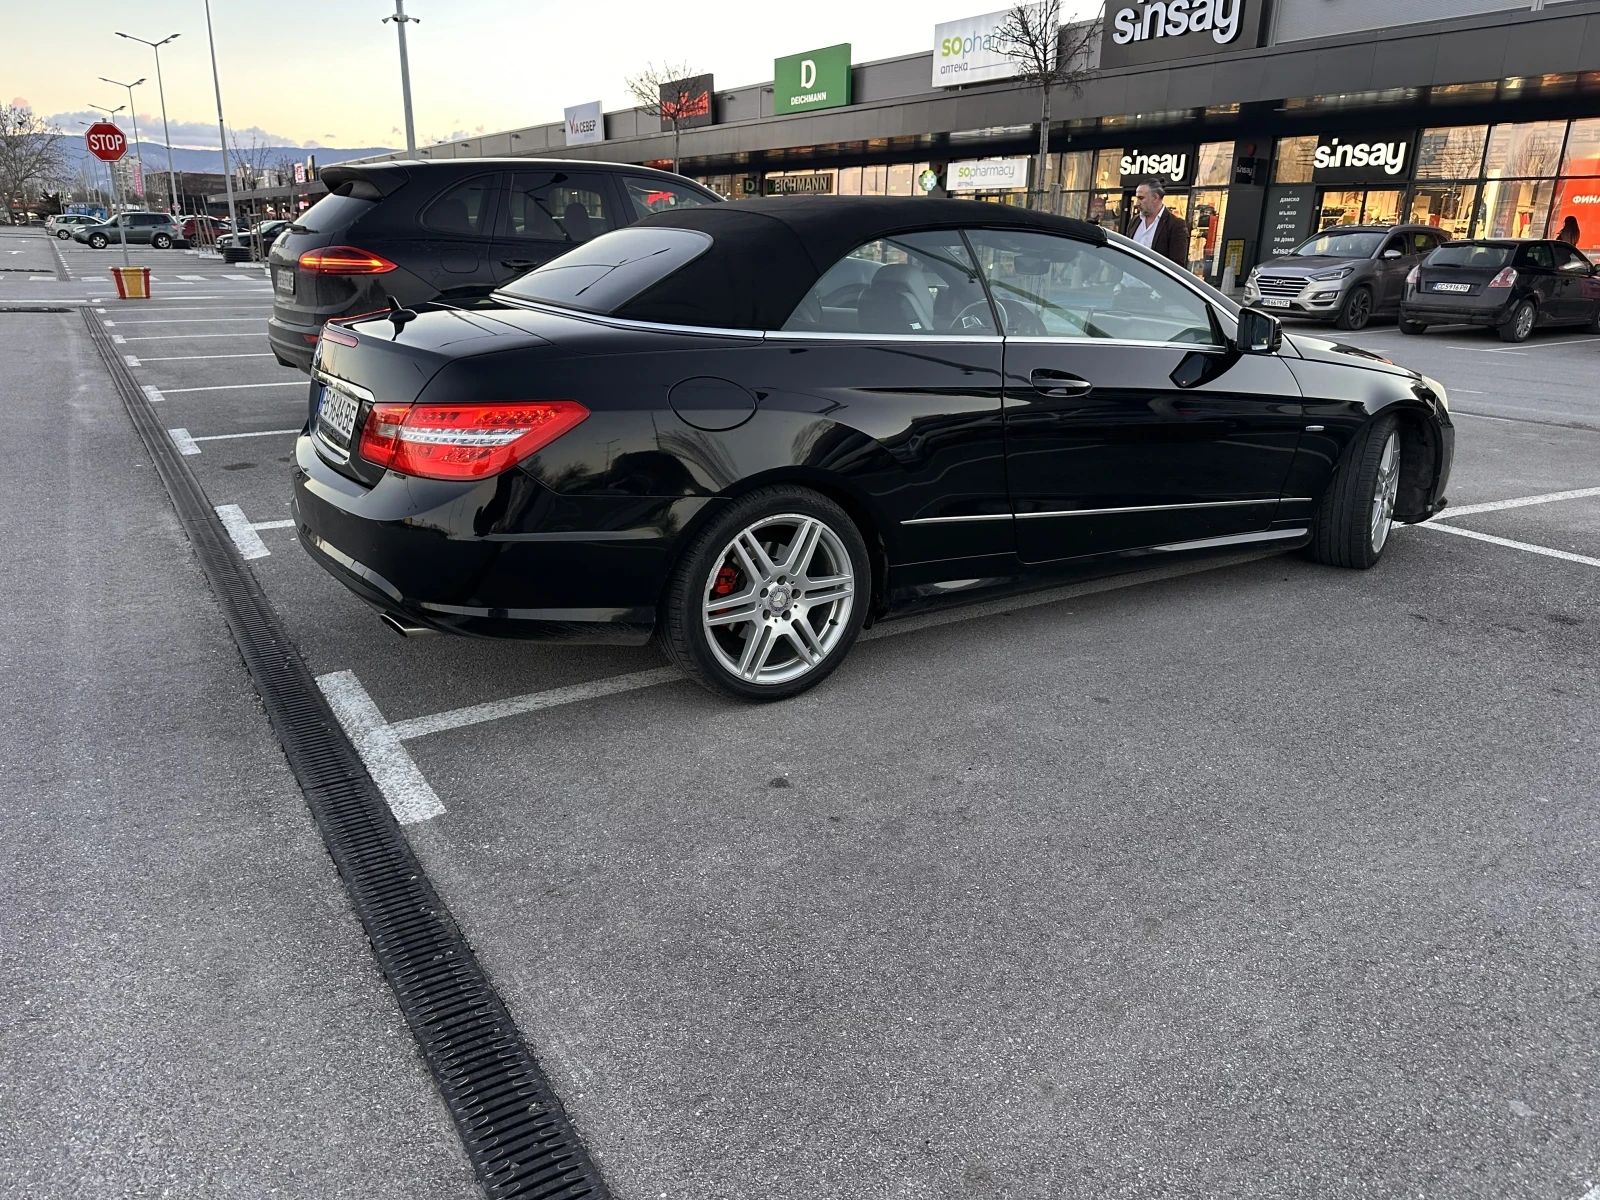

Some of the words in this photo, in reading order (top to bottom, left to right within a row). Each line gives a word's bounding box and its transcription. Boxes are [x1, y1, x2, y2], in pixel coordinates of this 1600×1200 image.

[1112, 0, 1240, 44] sinsay
[800, 59, 817, 89] D
[940, 62, 969, 75] аптека
[790, 91, 827, 106] DEICHMANN
[89, 133, 123, 151] STOP
[1313, 137, 1407, 175] sinsay
[958, 165, 1015, 179] sopharmacy
[1119, 149, 1187, 182] sinsay
[1236, 164, 1253, 176] sinsay
[769, 176, 828, 193] DEICHMANN
